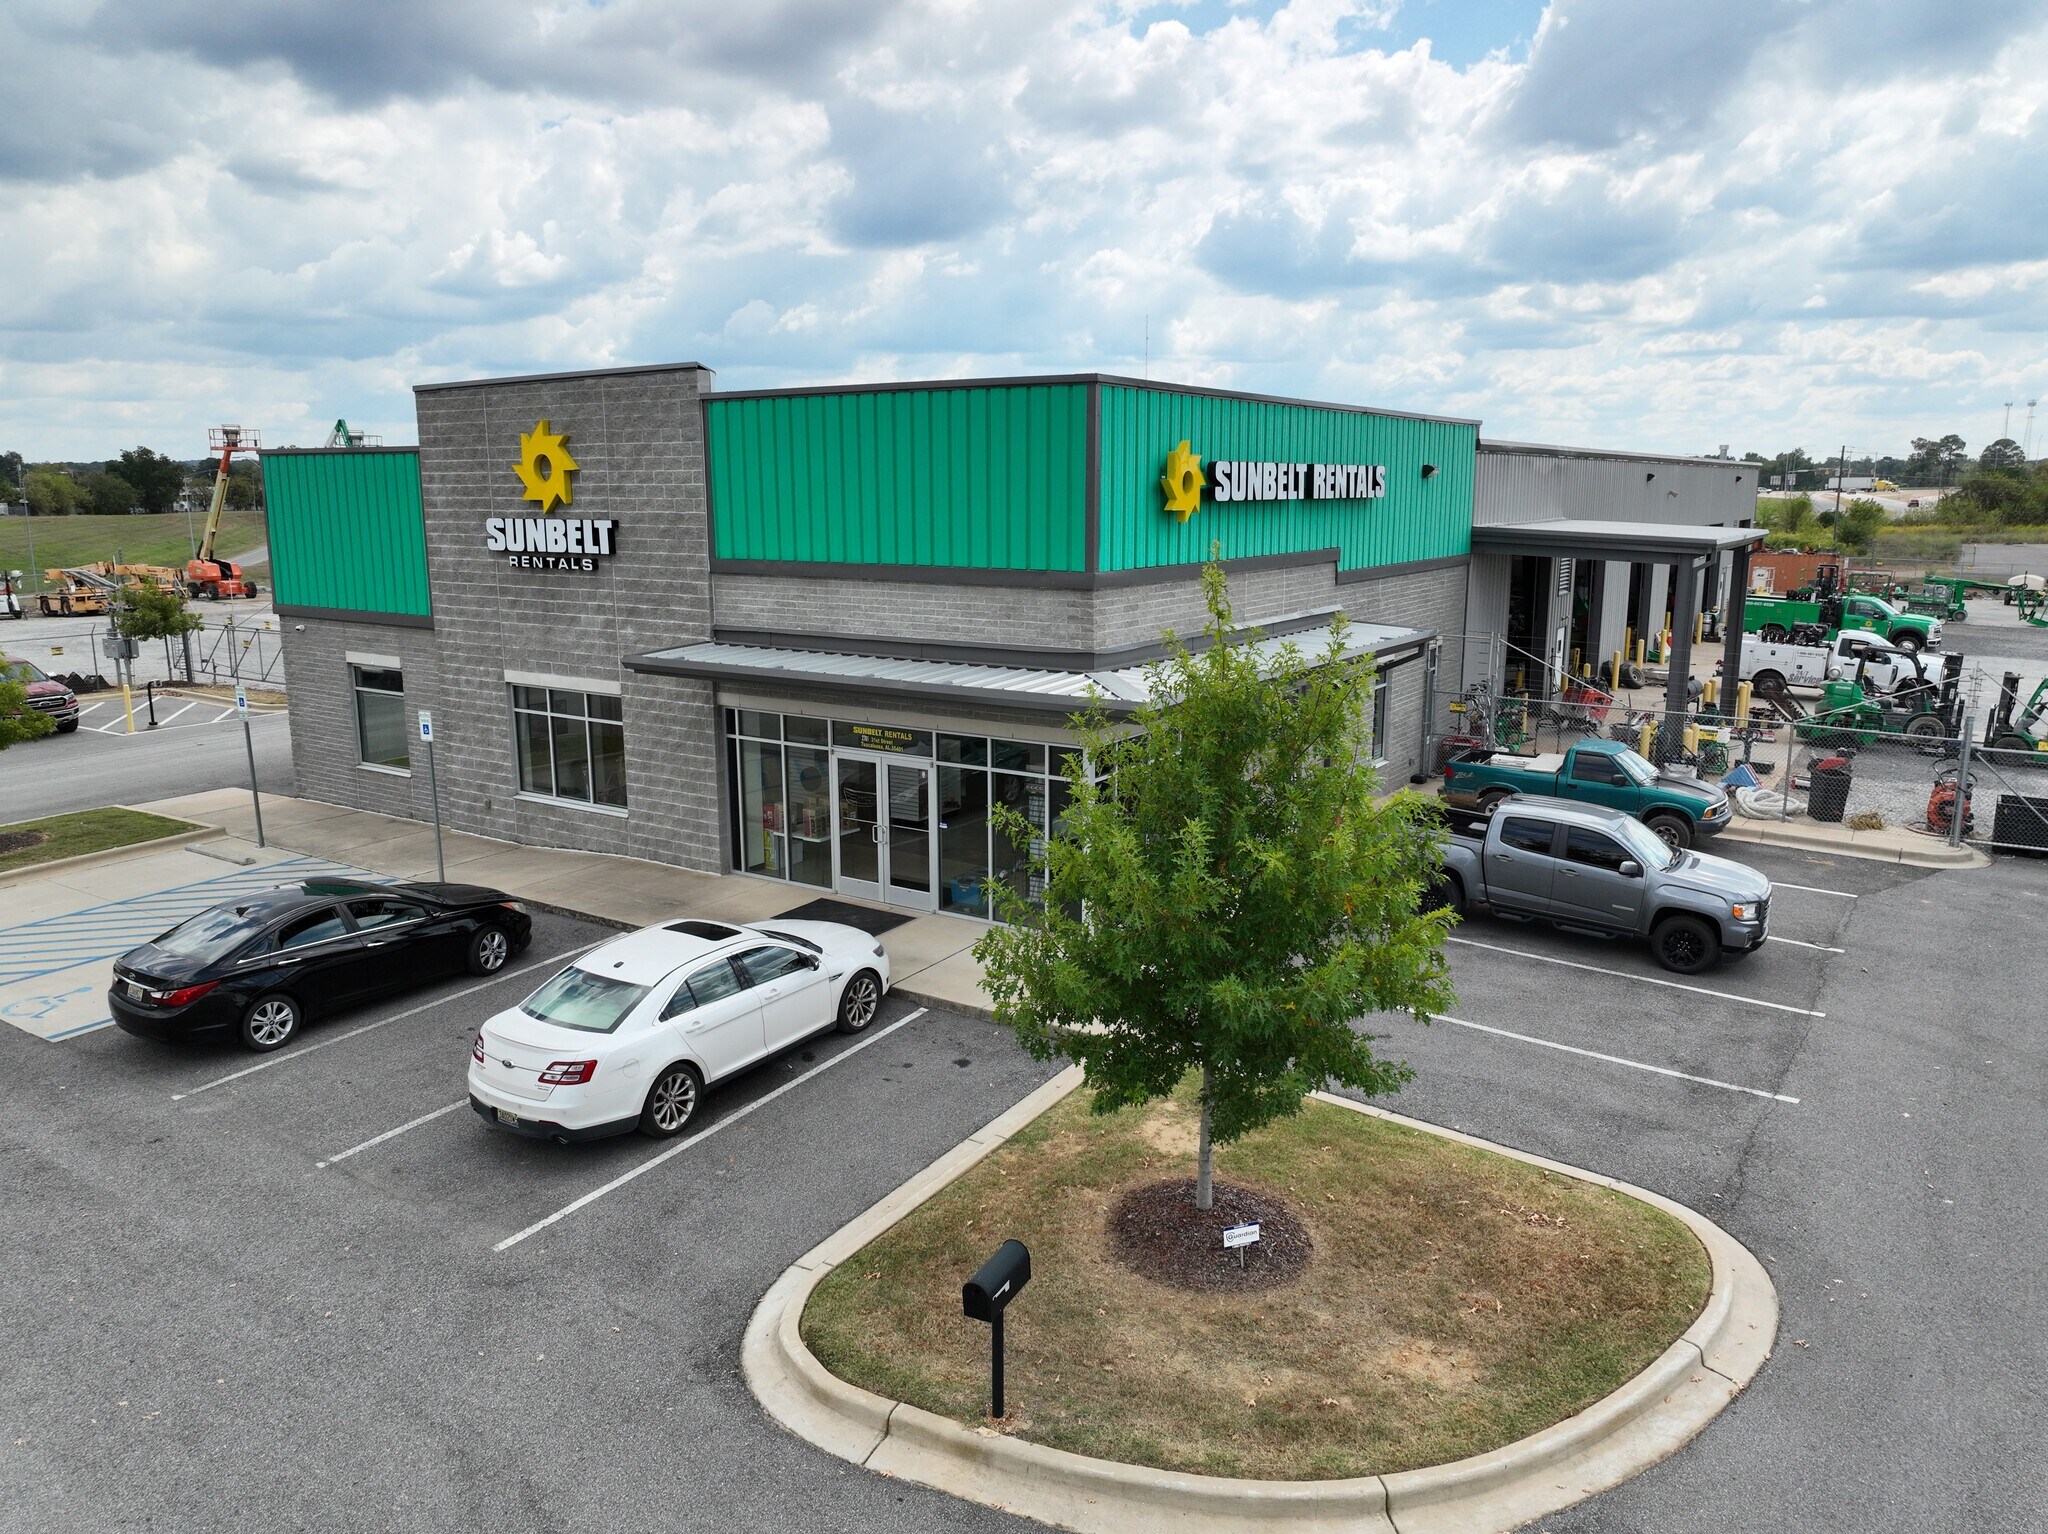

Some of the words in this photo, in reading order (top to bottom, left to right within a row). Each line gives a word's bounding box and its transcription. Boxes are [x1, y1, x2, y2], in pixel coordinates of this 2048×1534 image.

[1214, 460, 1308, 502] SUNBELT
[1312, 463, 1386, 499] RENTALS
[485, 517, 614, 555] SUNBELT
[509, 555, 594, 571] RENTALS
[853, 726, 882, 736] SUNBELT
[884, 731, 912, 740] RENTALS
